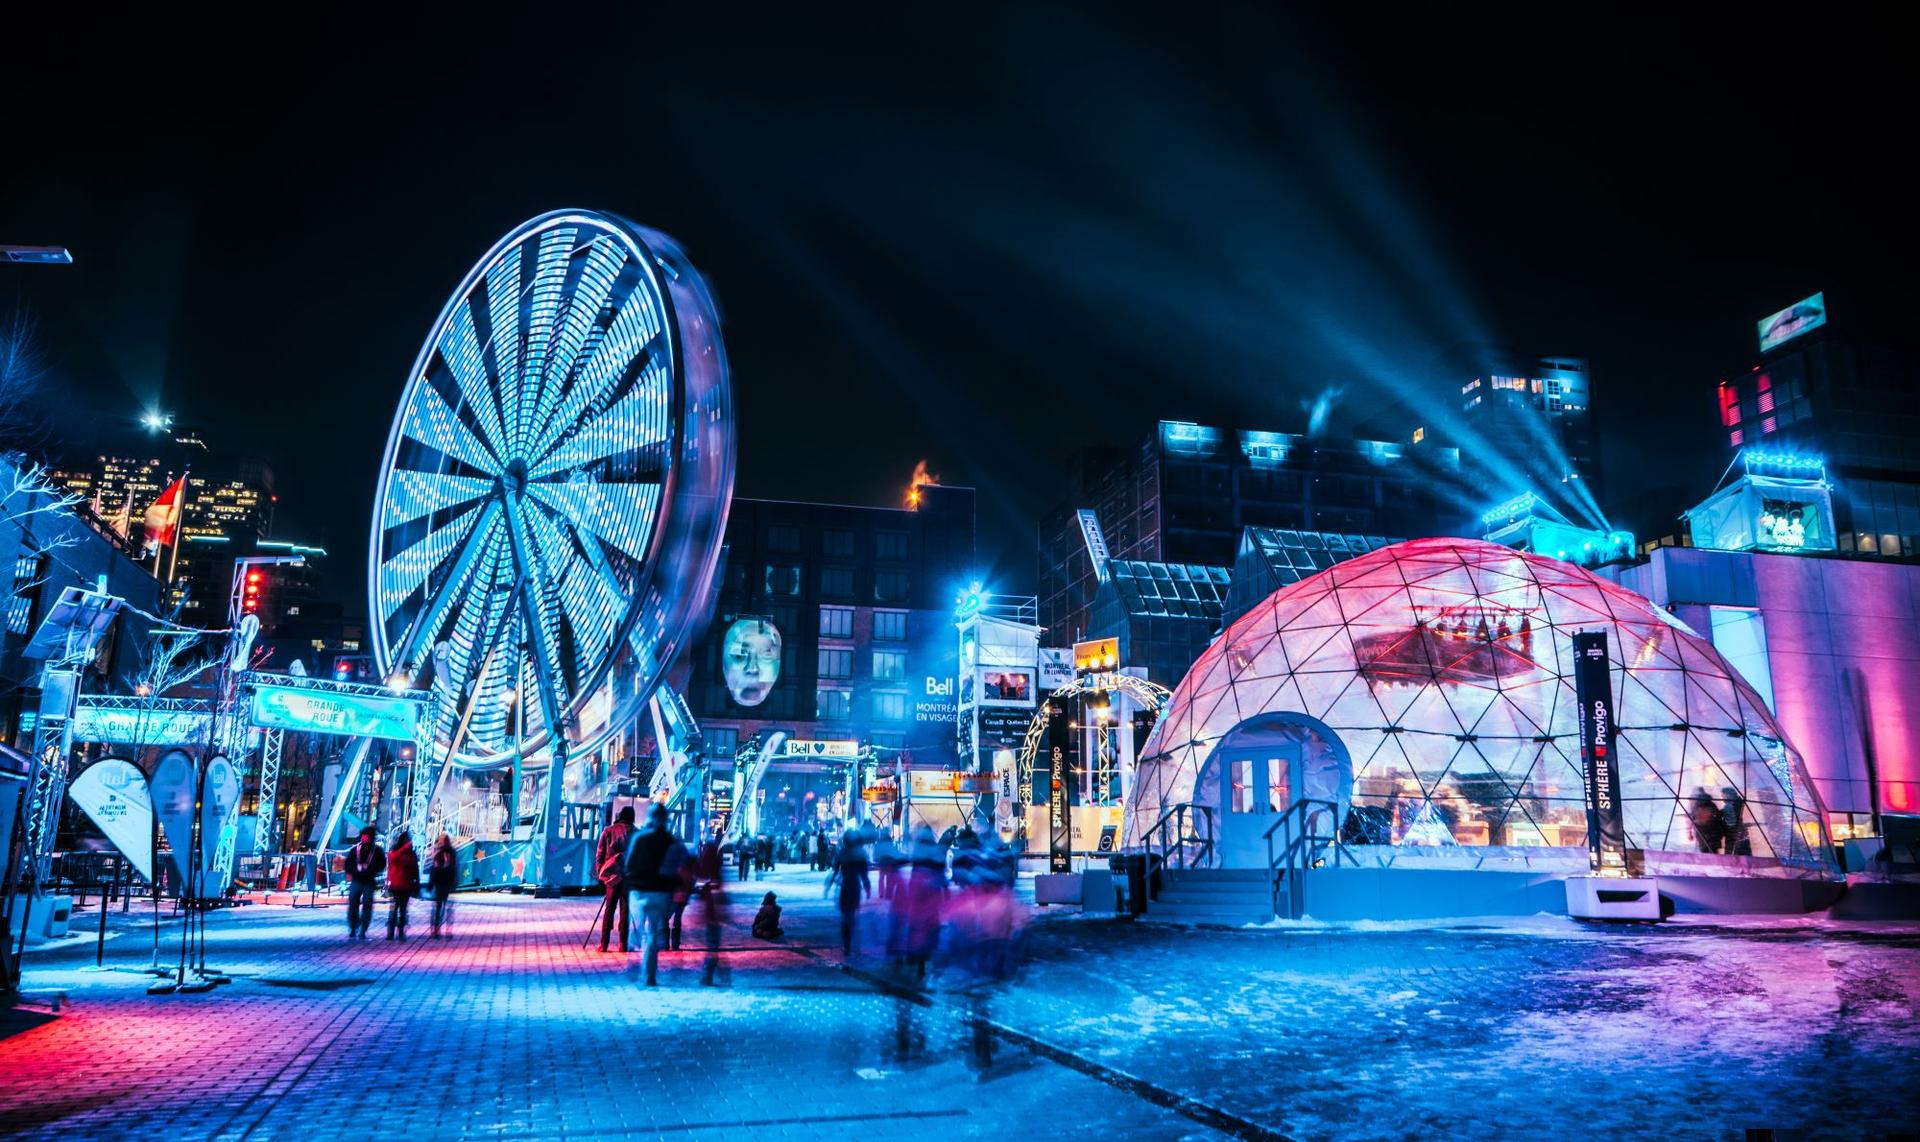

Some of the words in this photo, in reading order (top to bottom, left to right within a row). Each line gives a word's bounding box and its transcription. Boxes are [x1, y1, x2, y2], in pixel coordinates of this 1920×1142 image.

[926, 676, 953, 696] Bell
[306, 699, 345, 713] GRANDE
[916, 702, 958, 713] MONTRÉA
[312, 712, 339, 723] ROUE
[916, 713, 928, 721] EN
[929, 713, 958, 723] VISAGE
[1593, 700, 1608, 744] Provigo
[791, 742, 810, 754] Bell
[1052, 746, 1063, 780] Provigo
[1002, 767, 1010, 797] ESPACE
[1595, 760, 1611, 809] SPHÈRE
